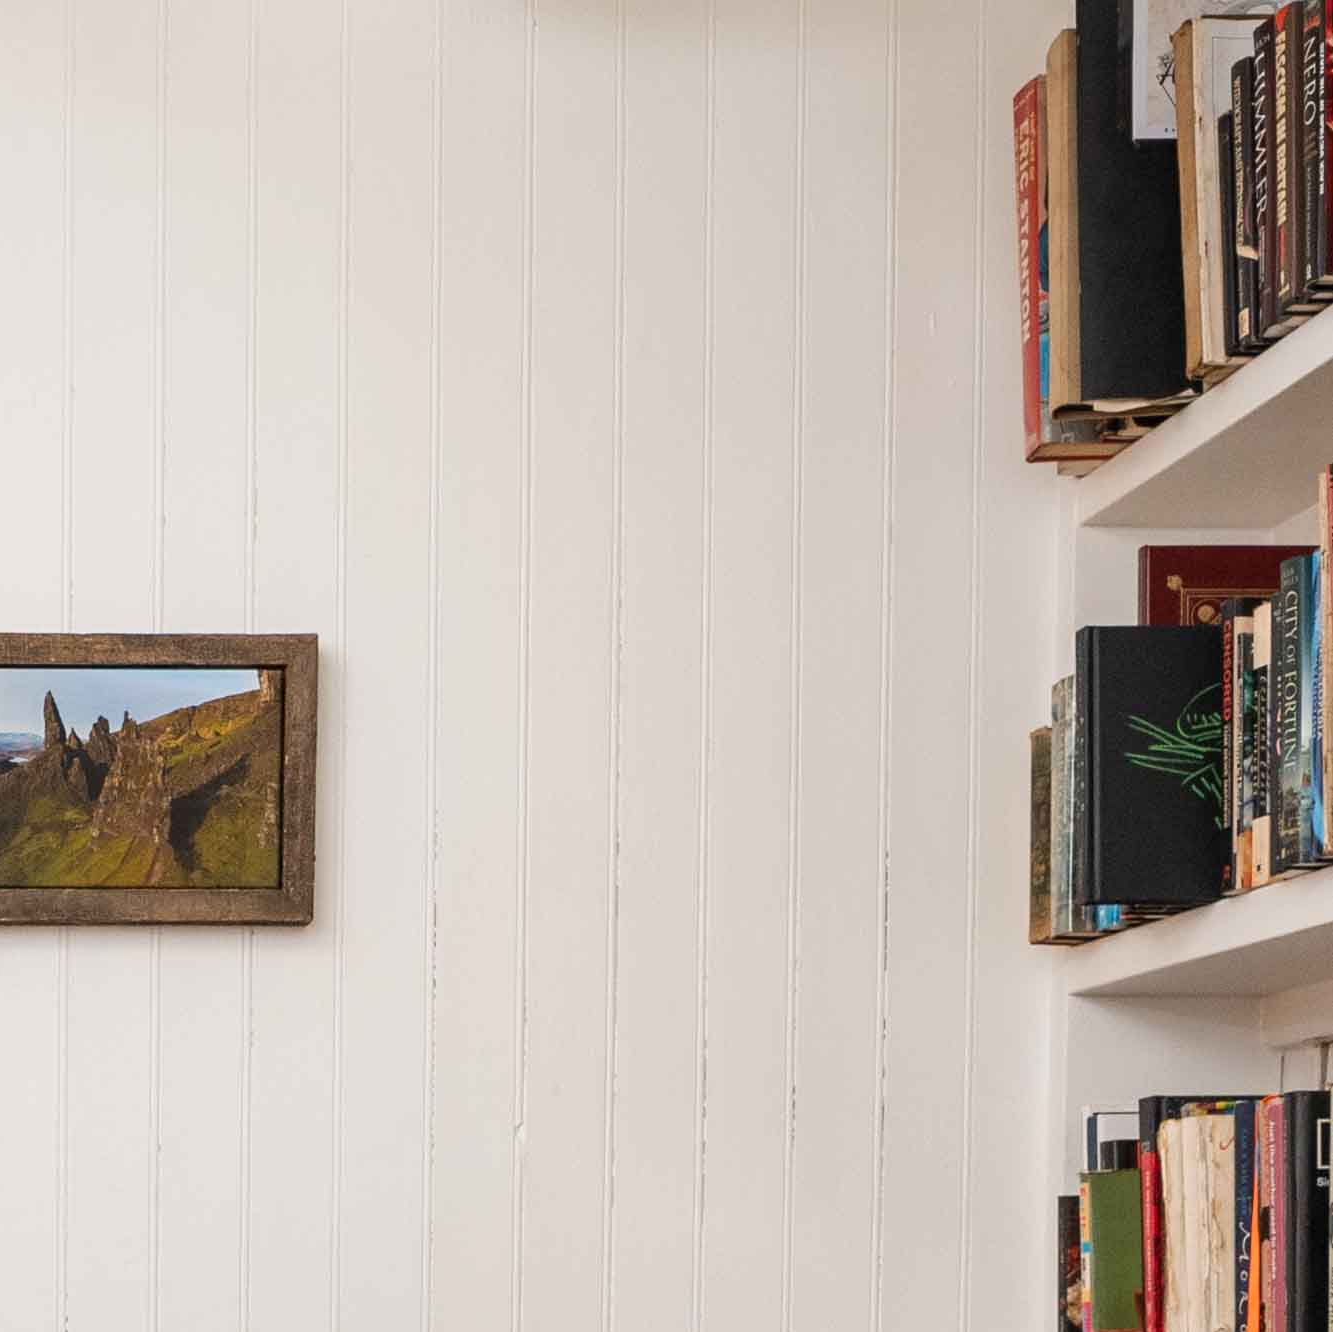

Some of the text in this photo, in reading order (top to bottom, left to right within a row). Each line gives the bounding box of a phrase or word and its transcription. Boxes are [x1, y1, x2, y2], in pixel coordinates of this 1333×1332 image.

[1252, 52, 1268, 225] HIMMLER
[1275, 32, 1288, 226] FASCISM IN BRITAIN
[1303, 37, 1317, 126] NERO
[1019, 118, 1032, 343] ERIC STANTON
[1222, 620, 1233, 721] CENSORED
[1283, 591, 1299, 641] CITY
